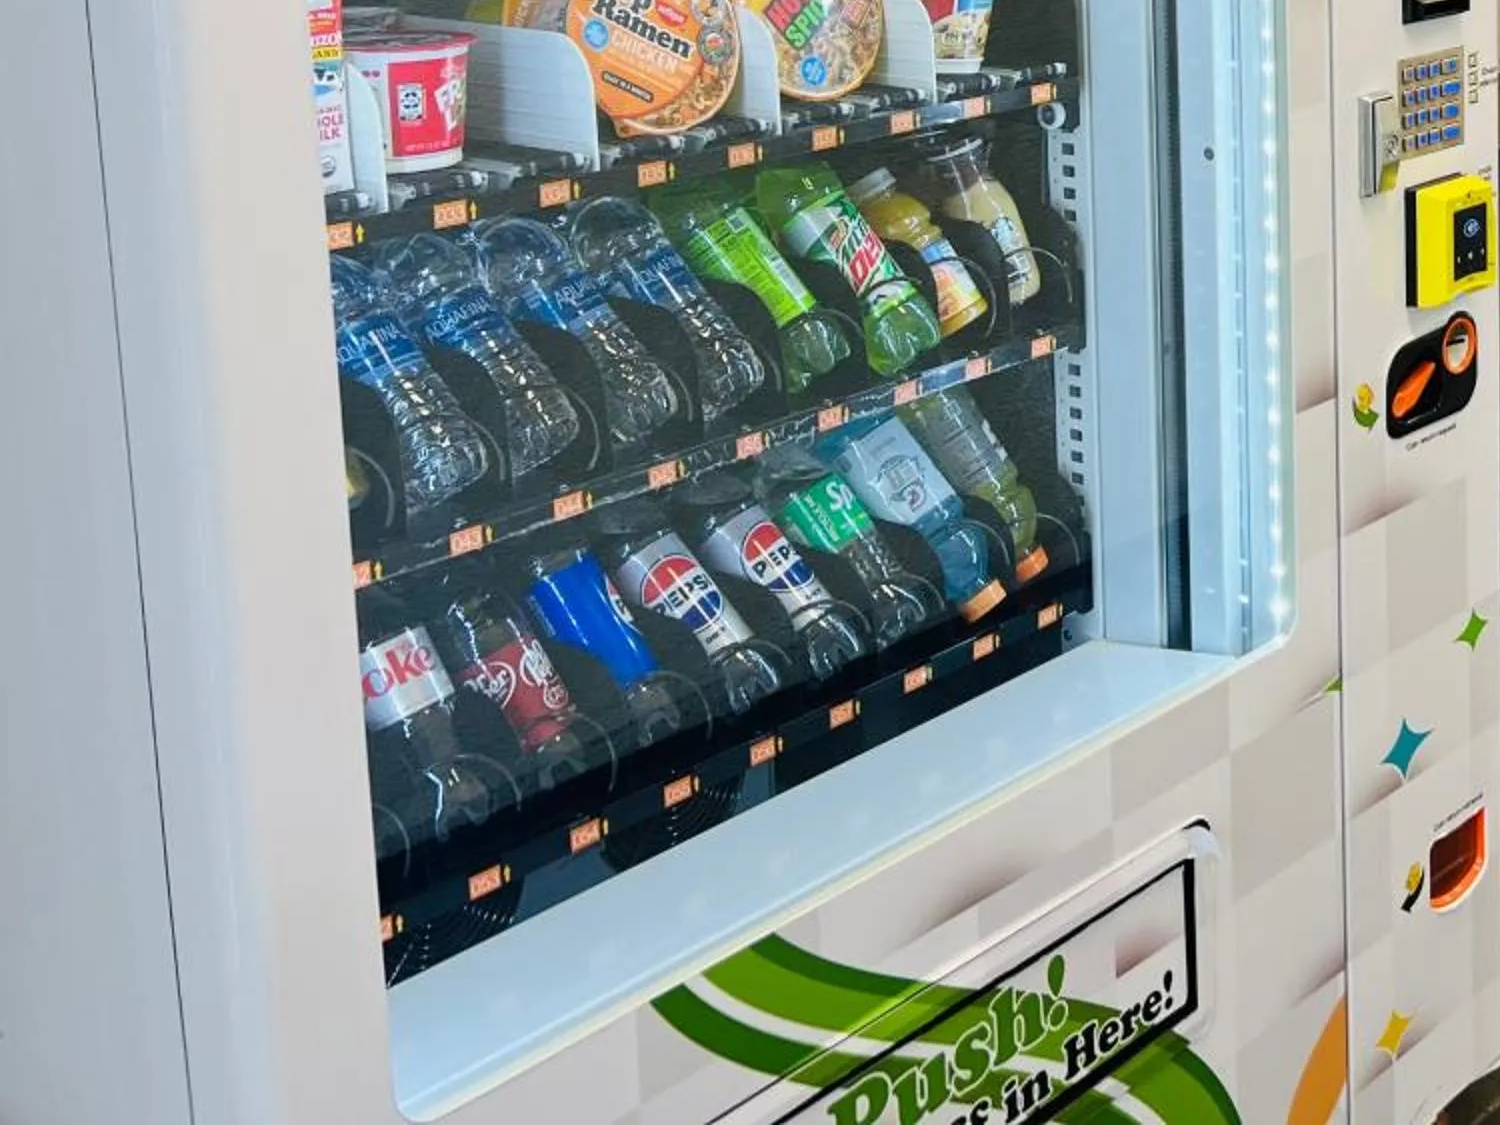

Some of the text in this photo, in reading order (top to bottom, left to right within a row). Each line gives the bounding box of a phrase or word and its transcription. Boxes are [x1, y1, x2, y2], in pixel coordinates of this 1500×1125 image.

[826, 954, 1069, 1125] Push!
[1002, 969, 1174, 1124] in Here!
